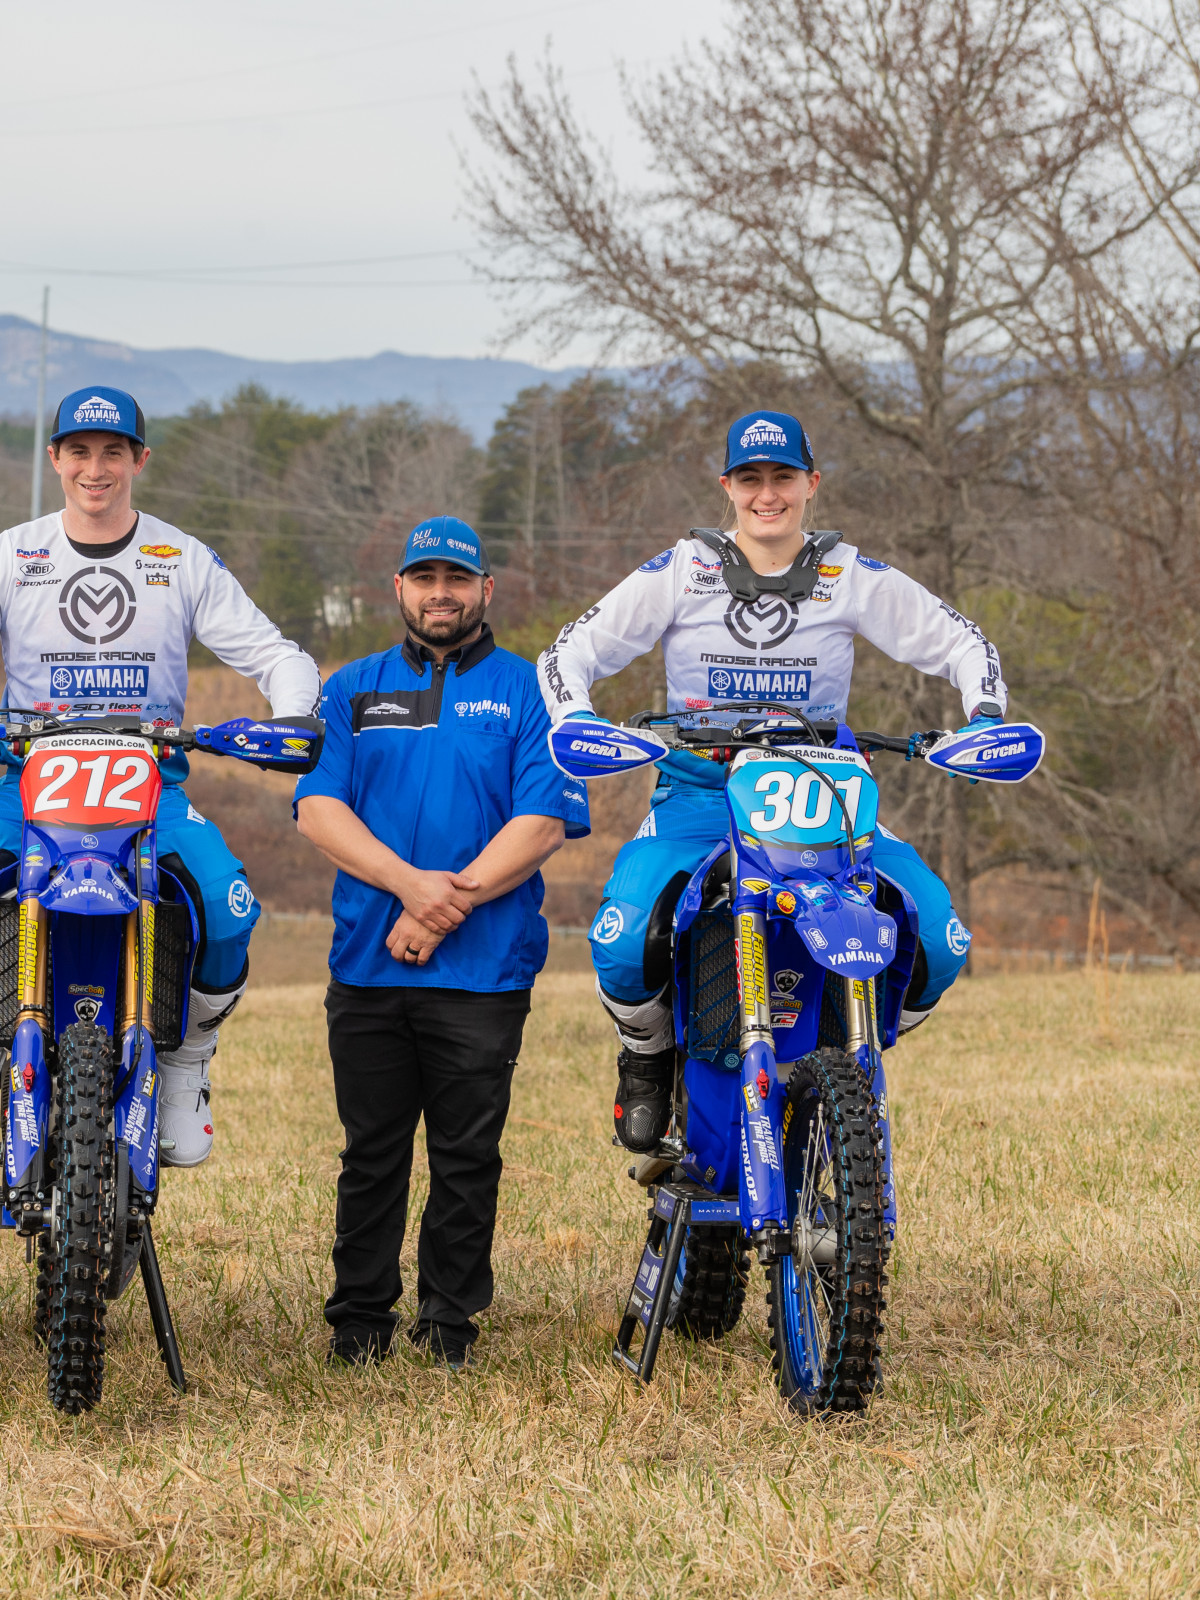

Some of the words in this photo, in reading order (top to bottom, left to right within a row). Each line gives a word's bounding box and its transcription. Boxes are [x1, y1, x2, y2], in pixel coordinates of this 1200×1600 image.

[84, 410, 120, 420] YAMAHA
[750, 432, 787, 443] YAMAHA
[420, 537, 440, 548] CRU
[454, 541, 477, 555] YAMAHA
[25, 564, 50, 574] SHOEI
[22, 579, 61, 587] DUNLOP
[696, 573, 720, 585] SHOEI
[40, 652, 96, 662] MOOSE
[99, 652, 156, 662] RACING
[700, 653, 756, 666] MOOSE
[760, 657, 817, 666] RACING
[73, 669, 144, 688] YAMAHA
[733, 672, 807, 692] YAMAHA
[718, 691, 801, 700] RACING
[51, 738, 145, 748] GNCCRACING.COM
[570, 740, 617, 758] CYCRA
[982, 742, 1026, 761] CYCRA
[33, 755, 150, 814] 212
[750, 770, 863, 832] 301
[63, 886, 114, 901] YAMAHA
[810, 930, 825, 948] SHOEI
[18, 904, 27, 1001] Connection
[26, 920, 38, 988] Factory
[828, 951, 884, 965] YAMAHA
[741, 915, 755, 1016] Connection
[752, 932, 766, 1006] Factory
[68, 985, 104, 995] Specbolt
[744, 1084, 759, 1110] DP
[13, 1100, 26, 1122] TIRE
[23, 1093, 40, 1147] TRAMMELL
[123, 1096, 141, 1142] RAMMELL
[136, 1105, 147, 1132] PROS
[15, 1118, 30, 1142] PROS
[131, 1125, 142, 1150] TIRE
[749, 1120, 763, 1144] TIRE
[753, 1140, 770, 1164] PROS
[760, 1115, 779, 1170] TRAMMELL
[740, 1126, 758, 1201] DUNLOP
